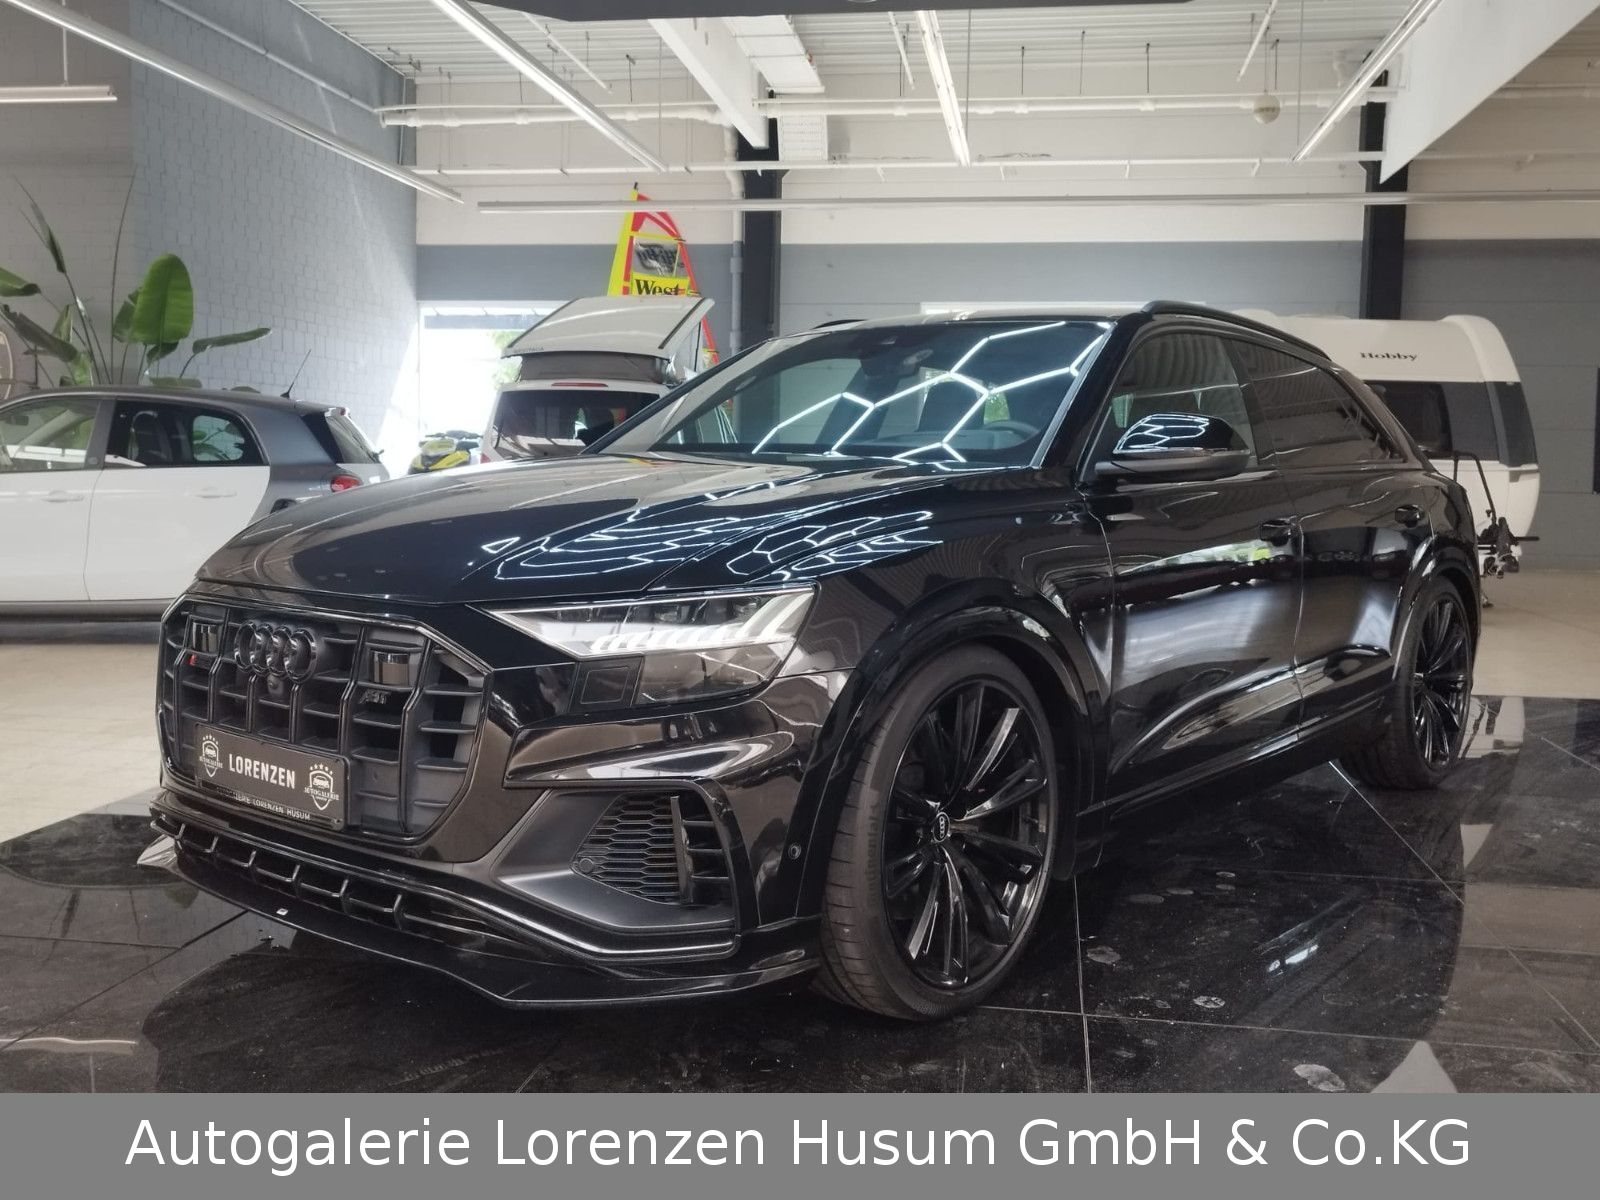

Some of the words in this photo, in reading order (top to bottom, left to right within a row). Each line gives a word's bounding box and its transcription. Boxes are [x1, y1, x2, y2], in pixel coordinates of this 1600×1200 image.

[635, 279, 679, 295] West
[1360, 352, 1417, 361] Hobby
[228, 753, 296, 789] LORENZEN
[286, 808, 311, 820] HUSUM
